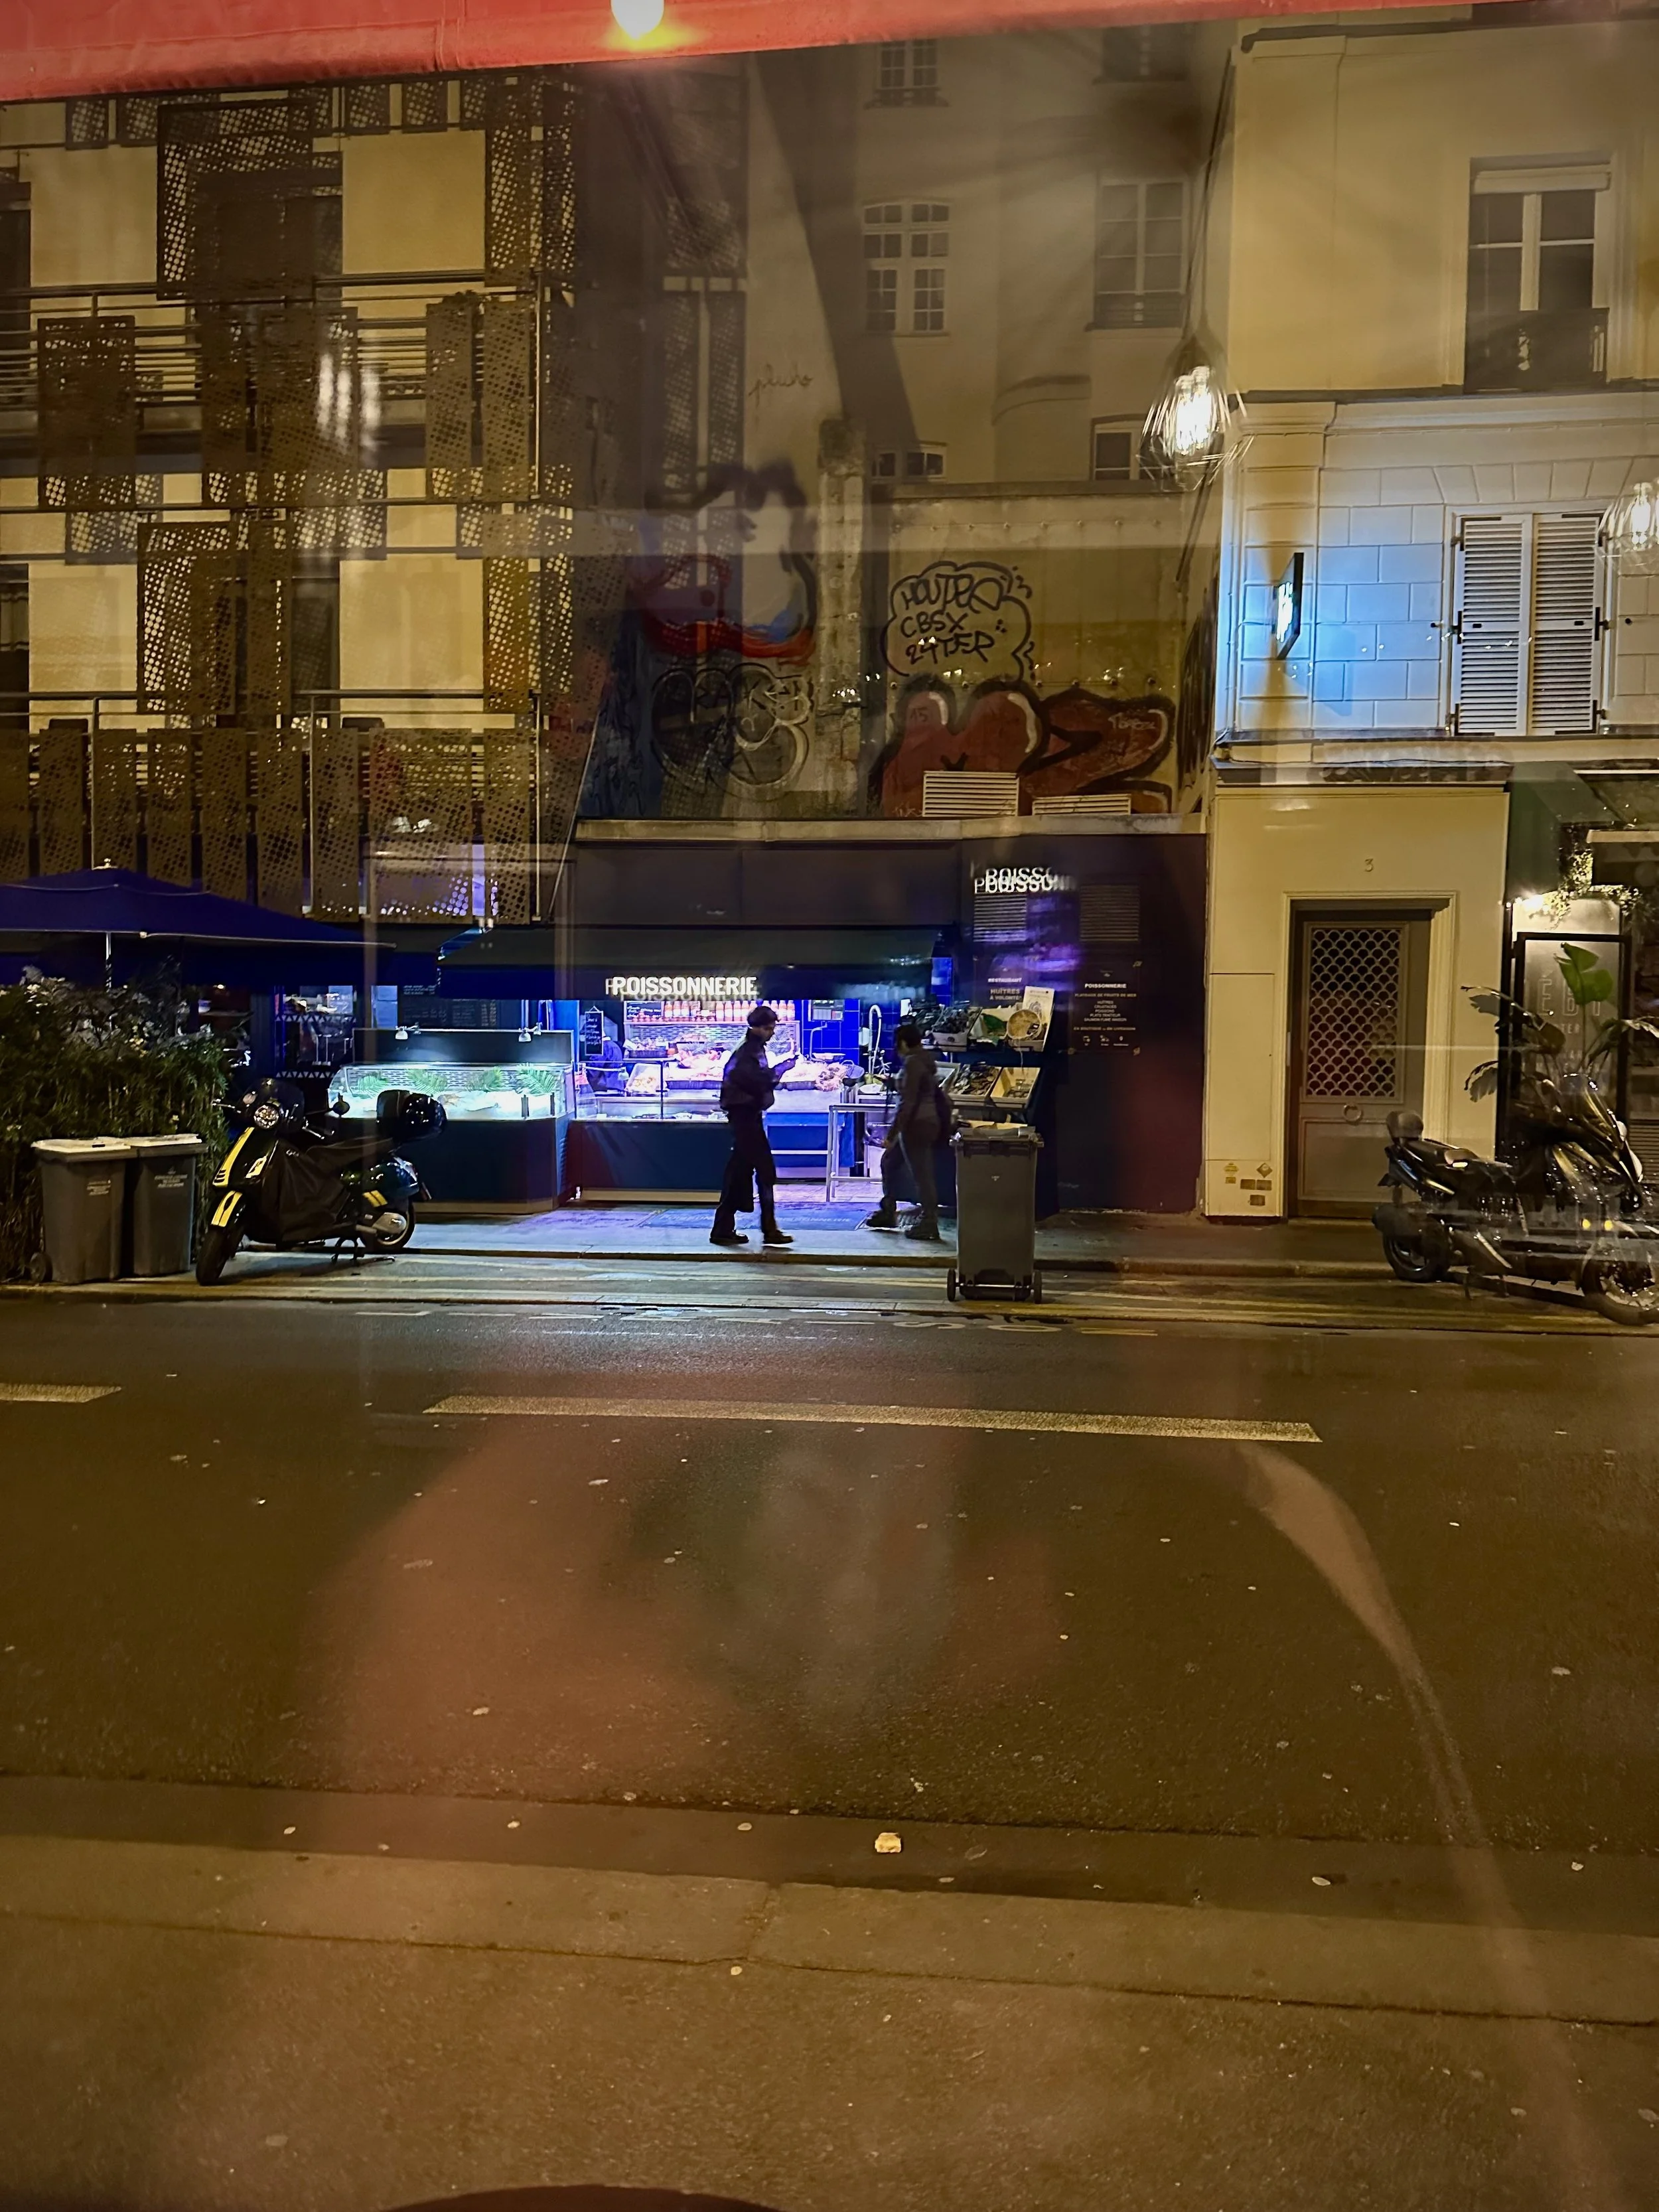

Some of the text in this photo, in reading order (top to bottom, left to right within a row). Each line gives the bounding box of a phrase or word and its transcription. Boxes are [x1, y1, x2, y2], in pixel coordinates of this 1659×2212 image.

[901, 611, 968, 638] CBSX
[1364, 858, 1375, 873] 3
[612, 976, 757, 996] POISSONNERIE
